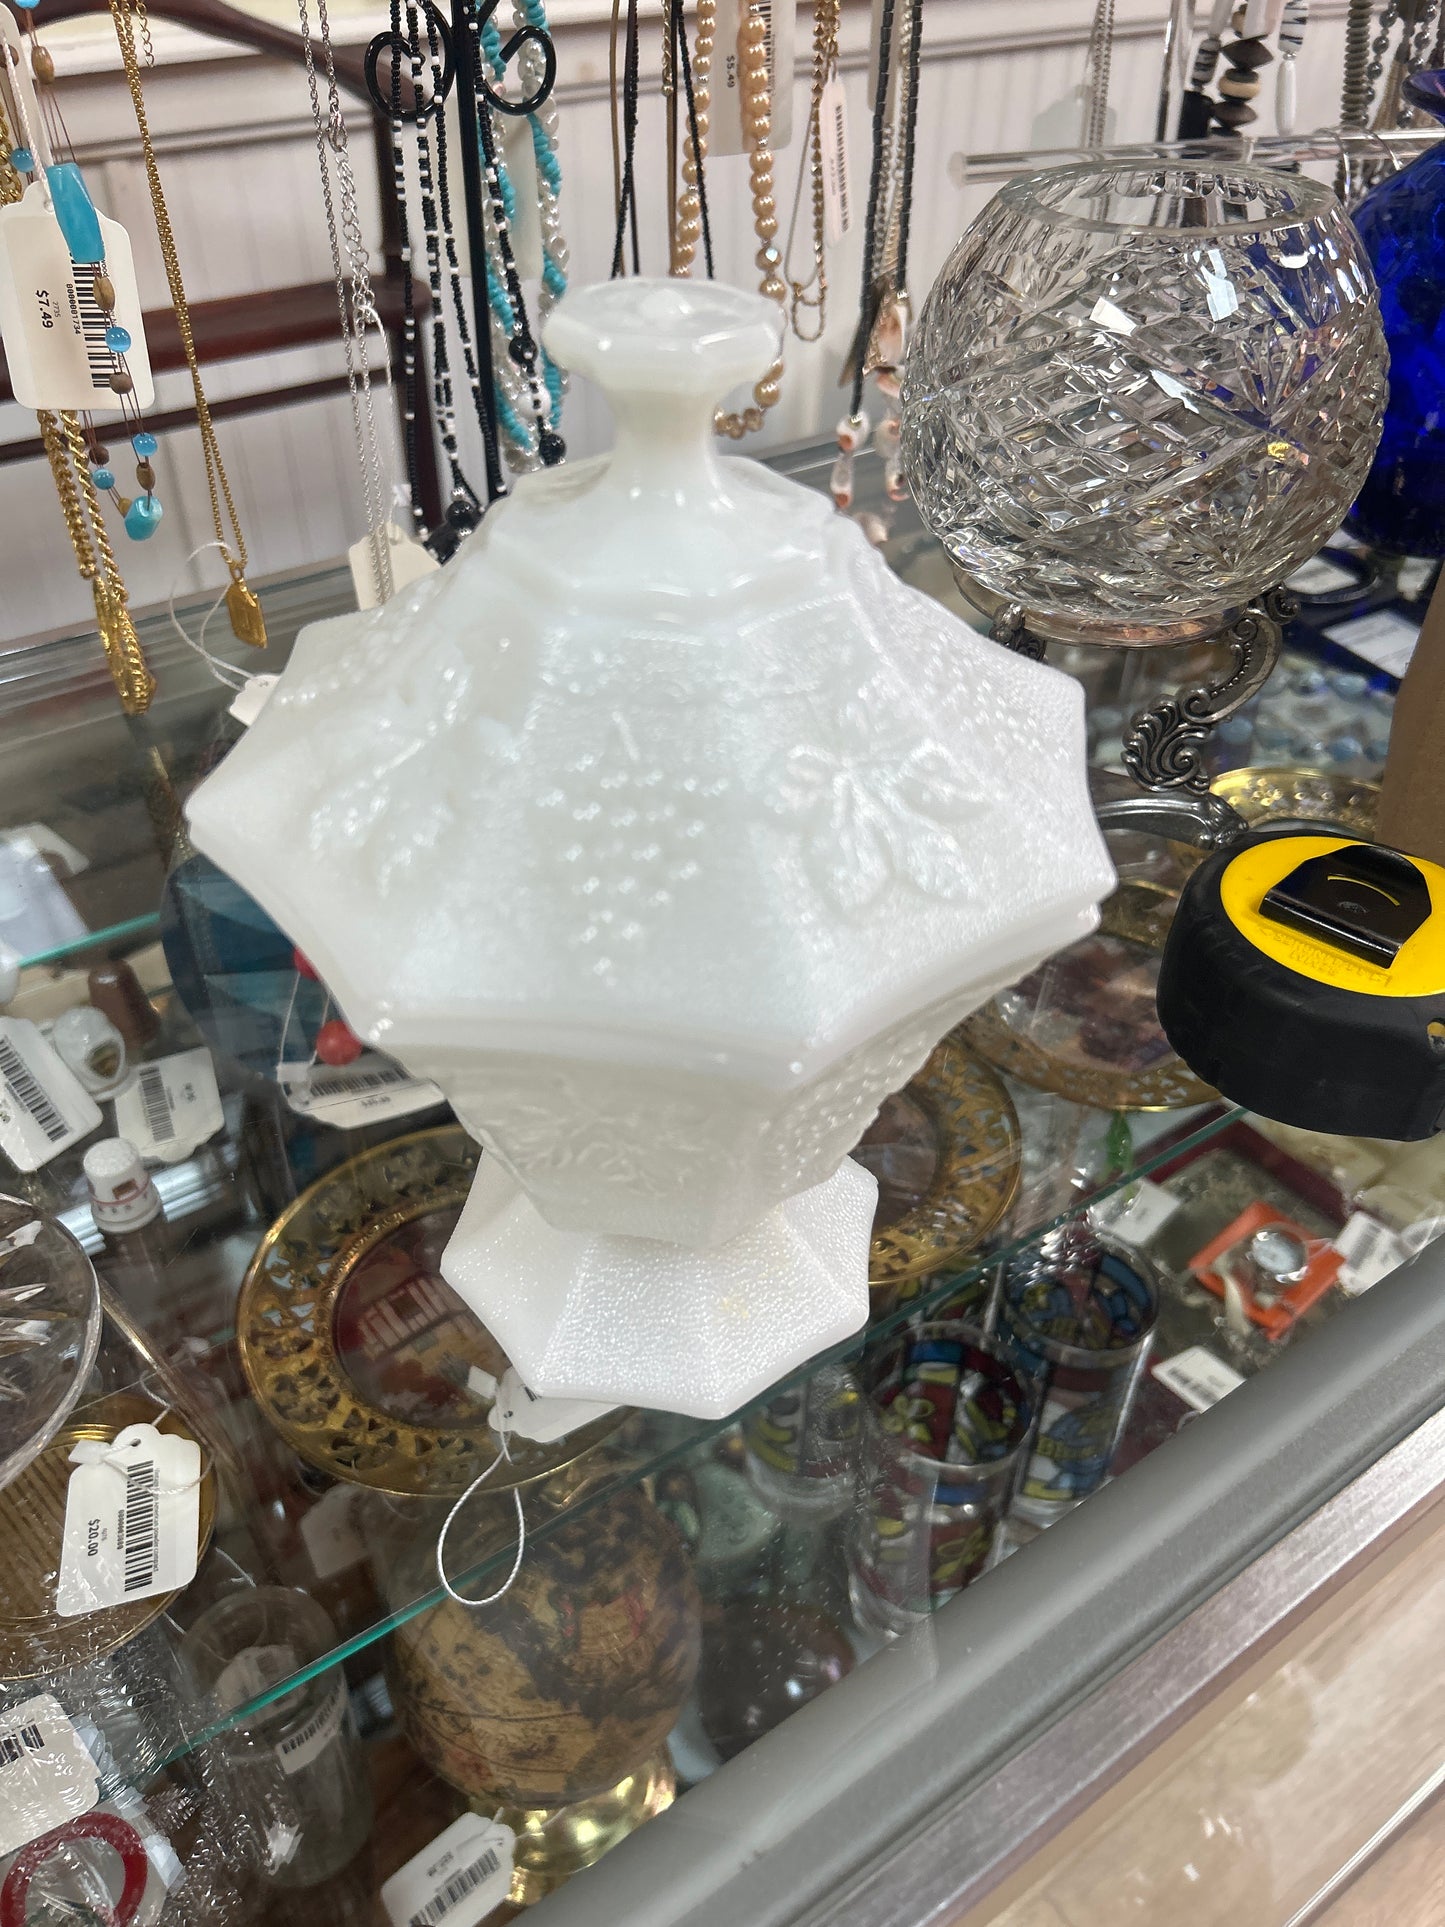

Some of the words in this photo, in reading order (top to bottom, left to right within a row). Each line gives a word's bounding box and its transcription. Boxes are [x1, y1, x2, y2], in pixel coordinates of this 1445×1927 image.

[726, 55, 735, 88] $5.49
[36, 290, 53, 328] $7.49
[88, 1519, 100, 1556] $20.00
